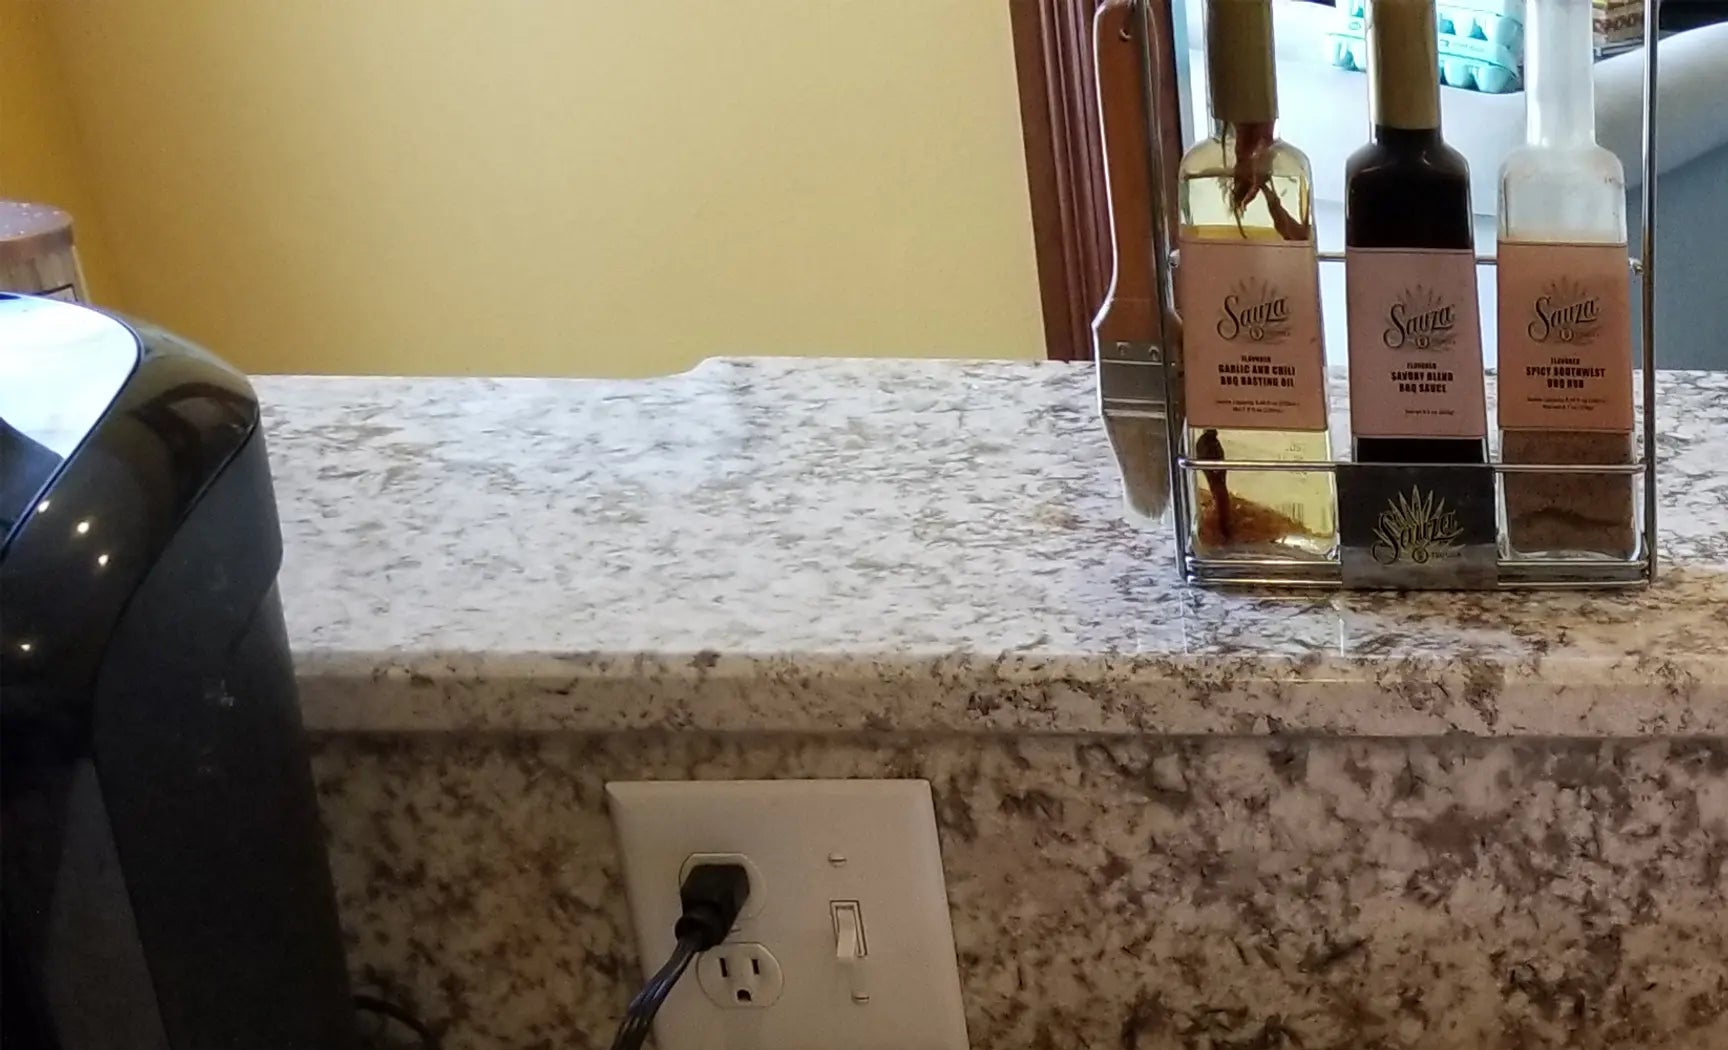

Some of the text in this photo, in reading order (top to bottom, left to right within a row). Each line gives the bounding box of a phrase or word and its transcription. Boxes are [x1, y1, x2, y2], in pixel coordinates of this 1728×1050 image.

[1217, 295, 1289, 340] Sauza
[1528, 296, 1599, 341] Sauza
[1383, 303, 1455, 349] Sauza
[1218, 364, 1296, 376] GARLIC AND CHILI
[1526, 366, 1606, 378] SPICY SOUTHWEST
[1220, 376, 1295, 388] BBQ BASTING OIL
[1391, 371, 1454, 382] SAVORY BLEND
[1399, 383, 1447, 393] BBQ SAUCE
[1372, 510, 1459, 564] Sauza
